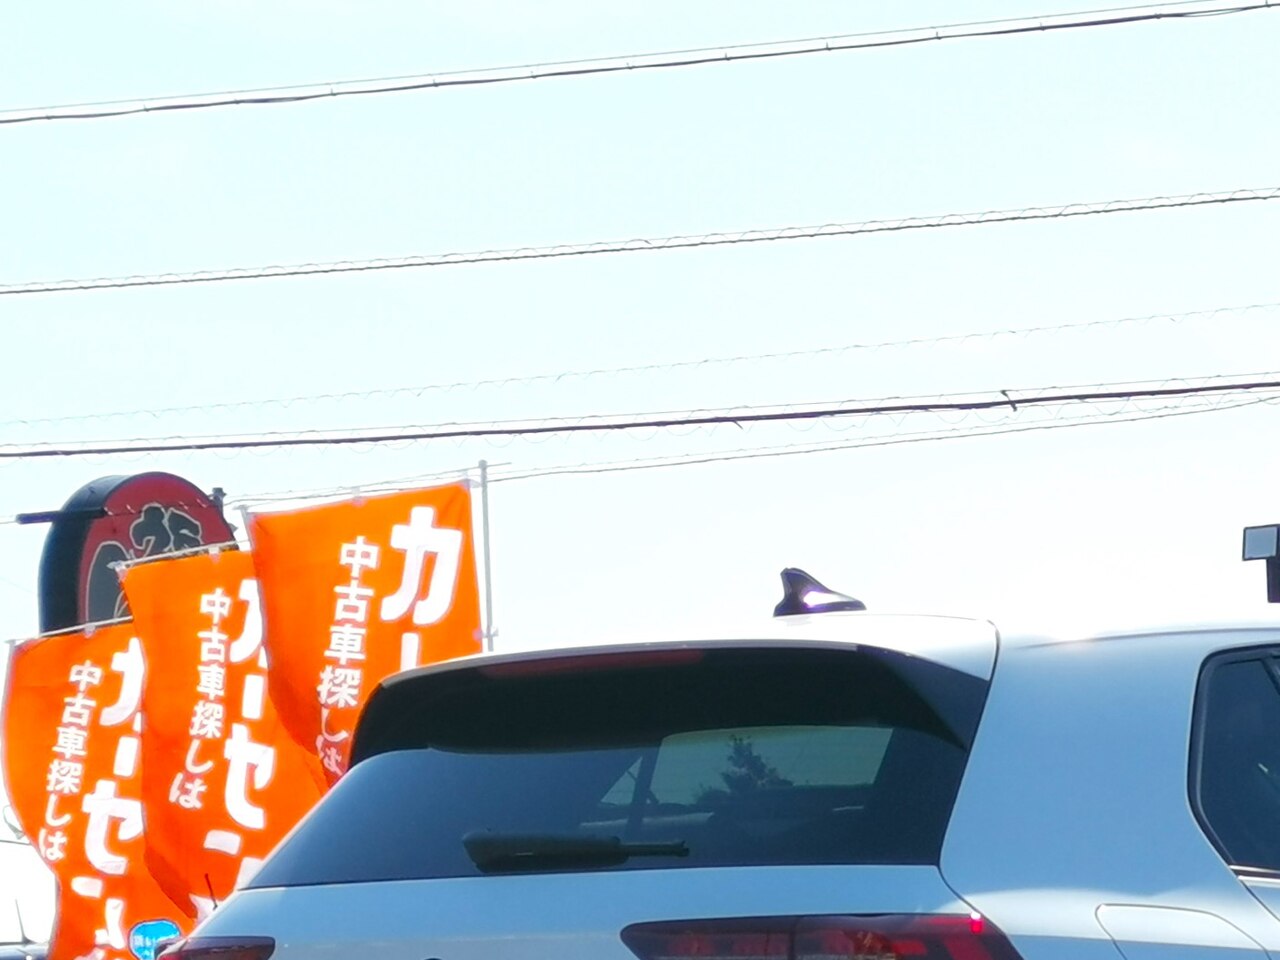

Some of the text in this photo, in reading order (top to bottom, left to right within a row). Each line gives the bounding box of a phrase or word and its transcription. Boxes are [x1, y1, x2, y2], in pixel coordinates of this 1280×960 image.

[316, 536, 379, 775] 中古車探しは
[380, 506, 462, 669] カー
[38, 661, 102, 862] 中古車探しは
[169, 588, 231, 808] 中古車探しは
